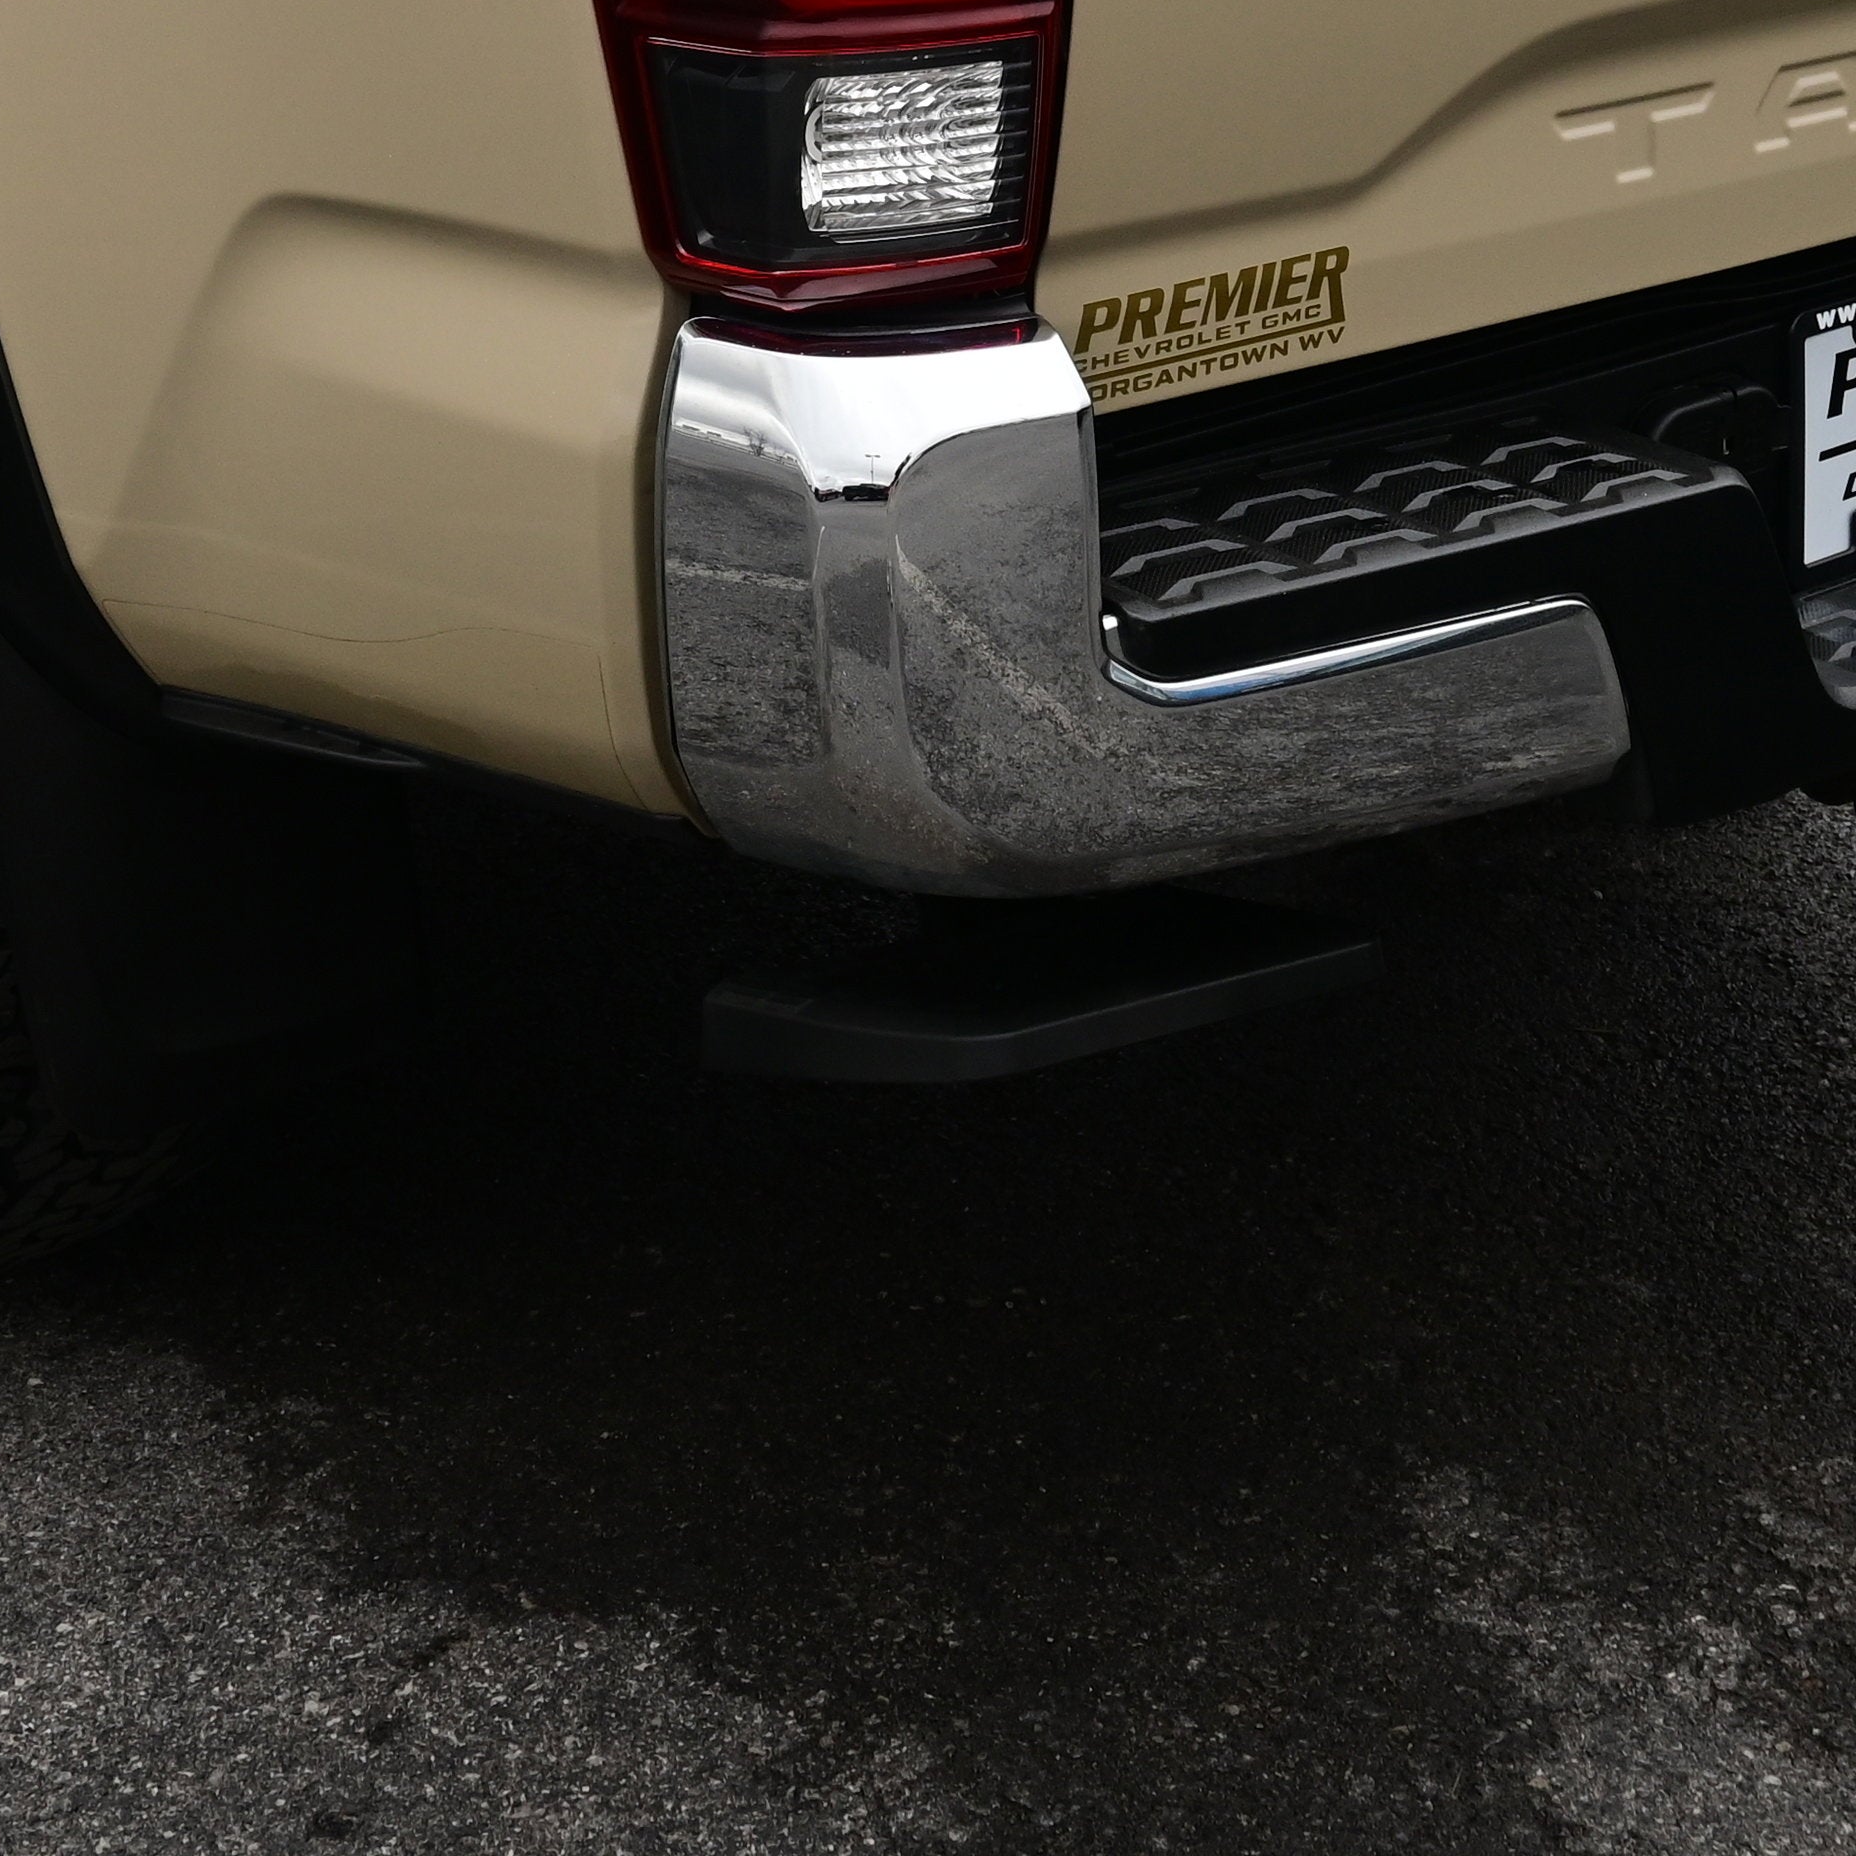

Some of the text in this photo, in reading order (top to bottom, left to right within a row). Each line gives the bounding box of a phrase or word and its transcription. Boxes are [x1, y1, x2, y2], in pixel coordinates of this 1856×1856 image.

[1073, 245, 1350, 356] PREMIER
[1075, 303, 1322, 373] CHEVROLET GMC
[1088, 326, 1346, 402] ORGANTOWN WV
